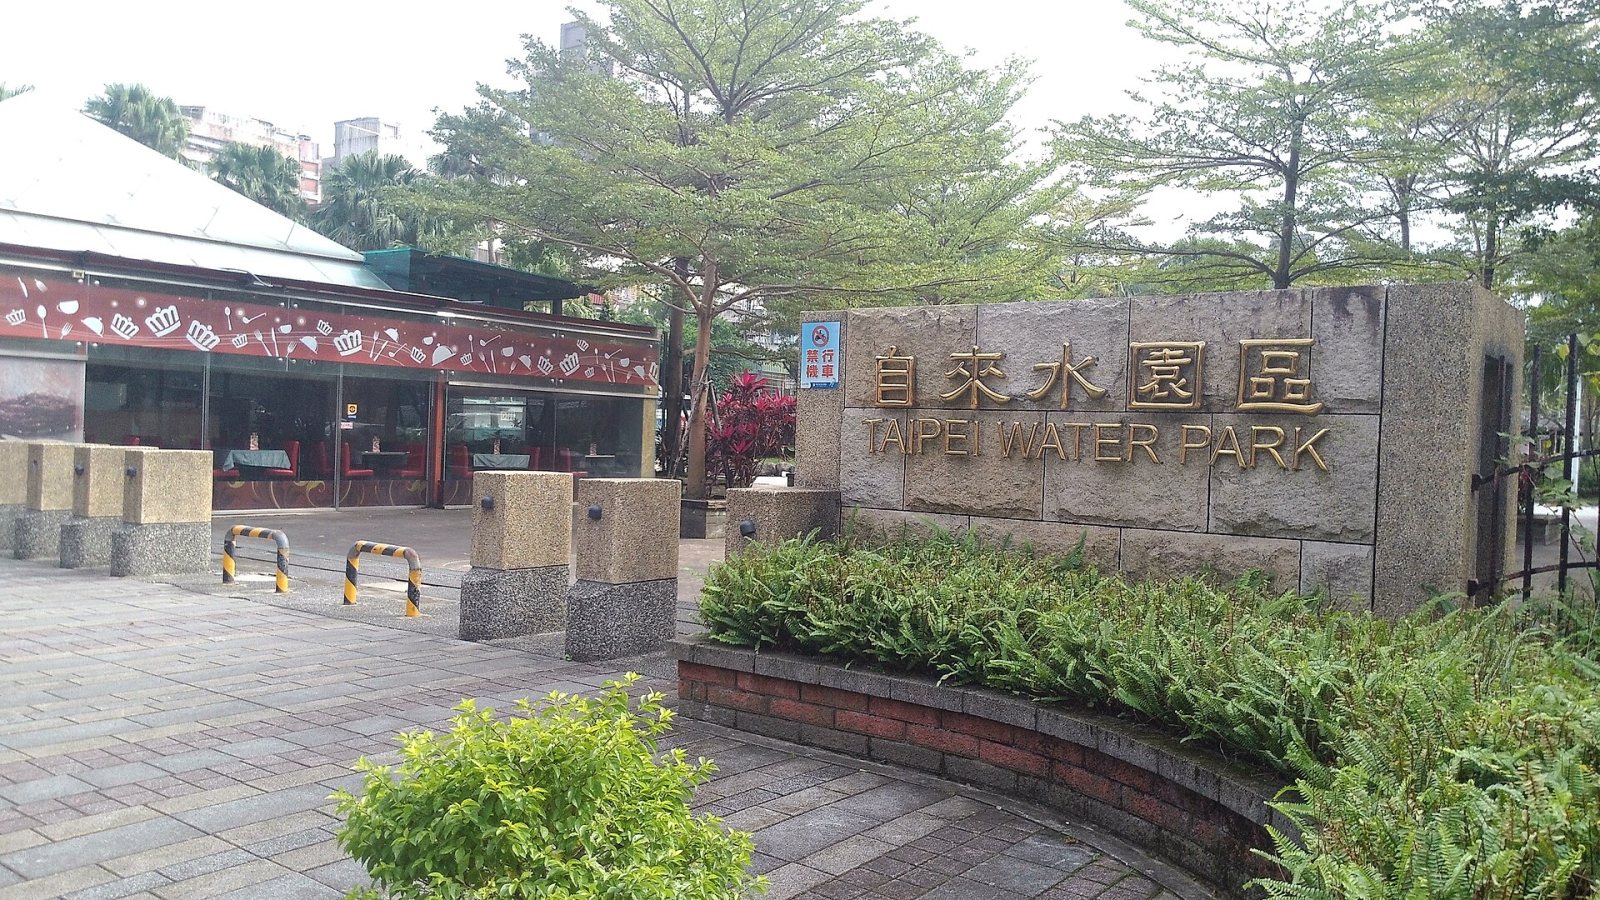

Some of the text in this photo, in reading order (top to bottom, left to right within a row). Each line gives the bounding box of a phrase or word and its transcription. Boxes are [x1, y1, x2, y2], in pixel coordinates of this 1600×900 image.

[806, 349, 834, 362] 禁行
[806, 364, 834, 378] 機車
[875, 338, 1323, 415] 自來水園區
[863, 418, 1330, 472] TAIPEI WATER PARK
